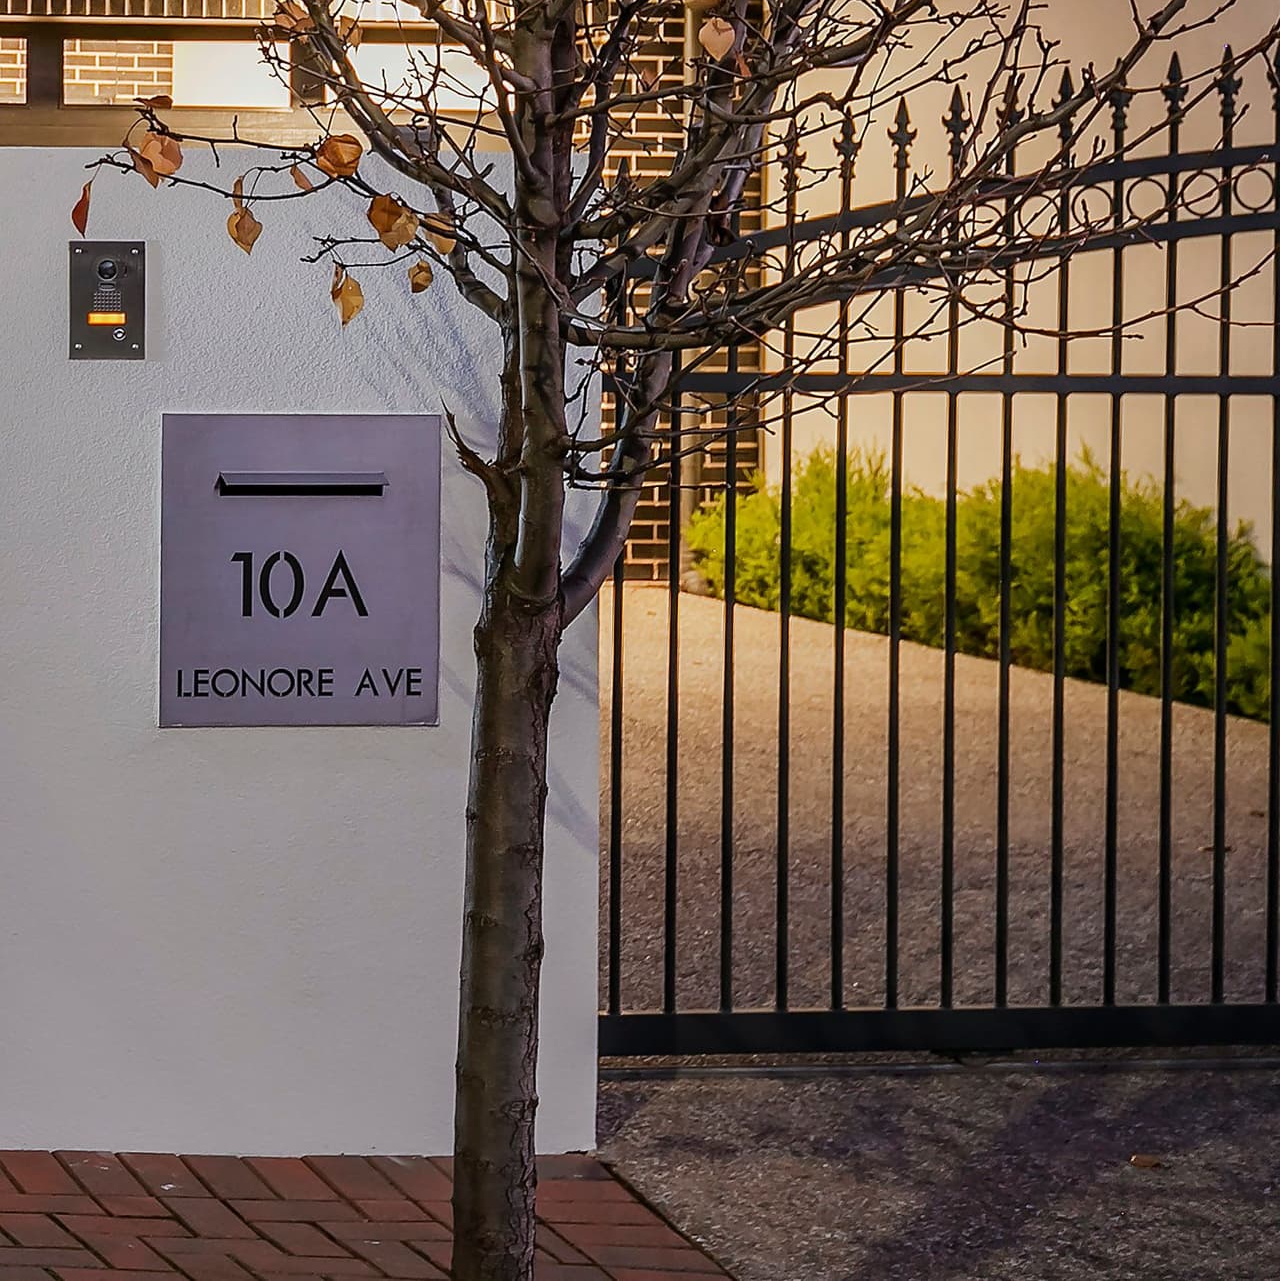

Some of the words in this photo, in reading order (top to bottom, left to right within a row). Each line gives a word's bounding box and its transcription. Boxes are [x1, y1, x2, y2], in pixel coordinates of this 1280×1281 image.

[230, 549, 369, 619] 10A
[176, 668, 334, 698] LEONORE
[354, 667, 422, 697] AVE
